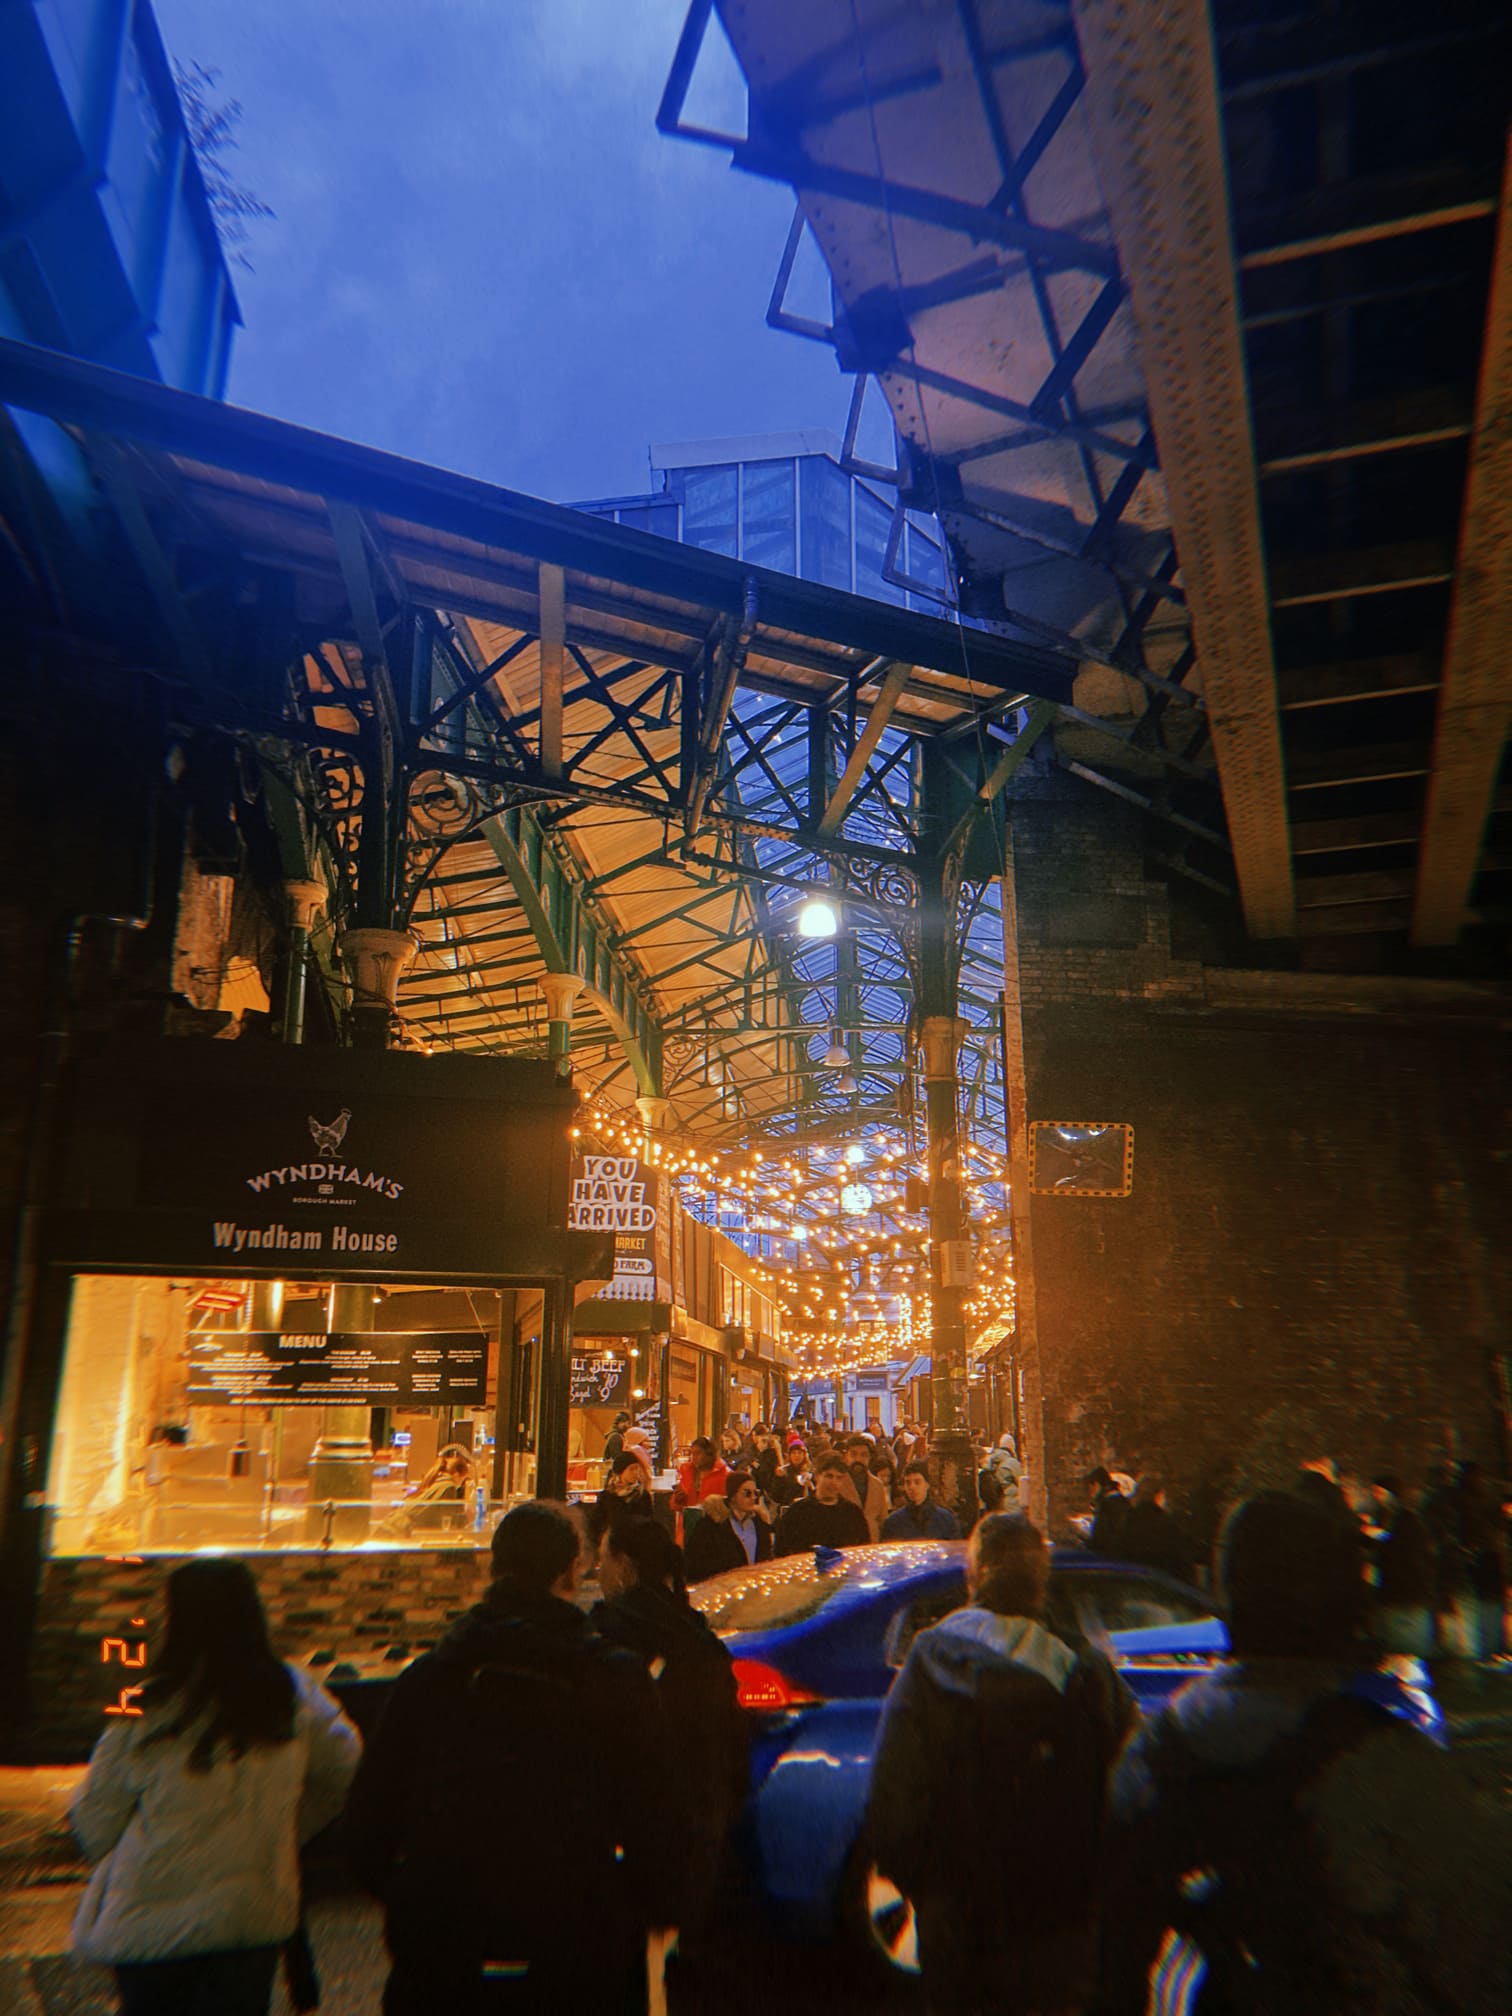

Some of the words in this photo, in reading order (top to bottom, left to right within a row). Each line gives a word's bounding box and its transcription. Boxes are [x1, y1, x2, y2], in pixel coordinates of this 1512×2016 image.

[585, 1157, 637, 1181] YOU
[246, 1163, 404, 1199] WYNDHAM'S
[575, 1181, 645, 1204] HAVE
[214, 1222, 322, 1252] Wyndham
[332, 1226, 398, 1251] House
[279, 1335, 327, 1348] MENU
[589, 1359, 626, 1374] BEEF
